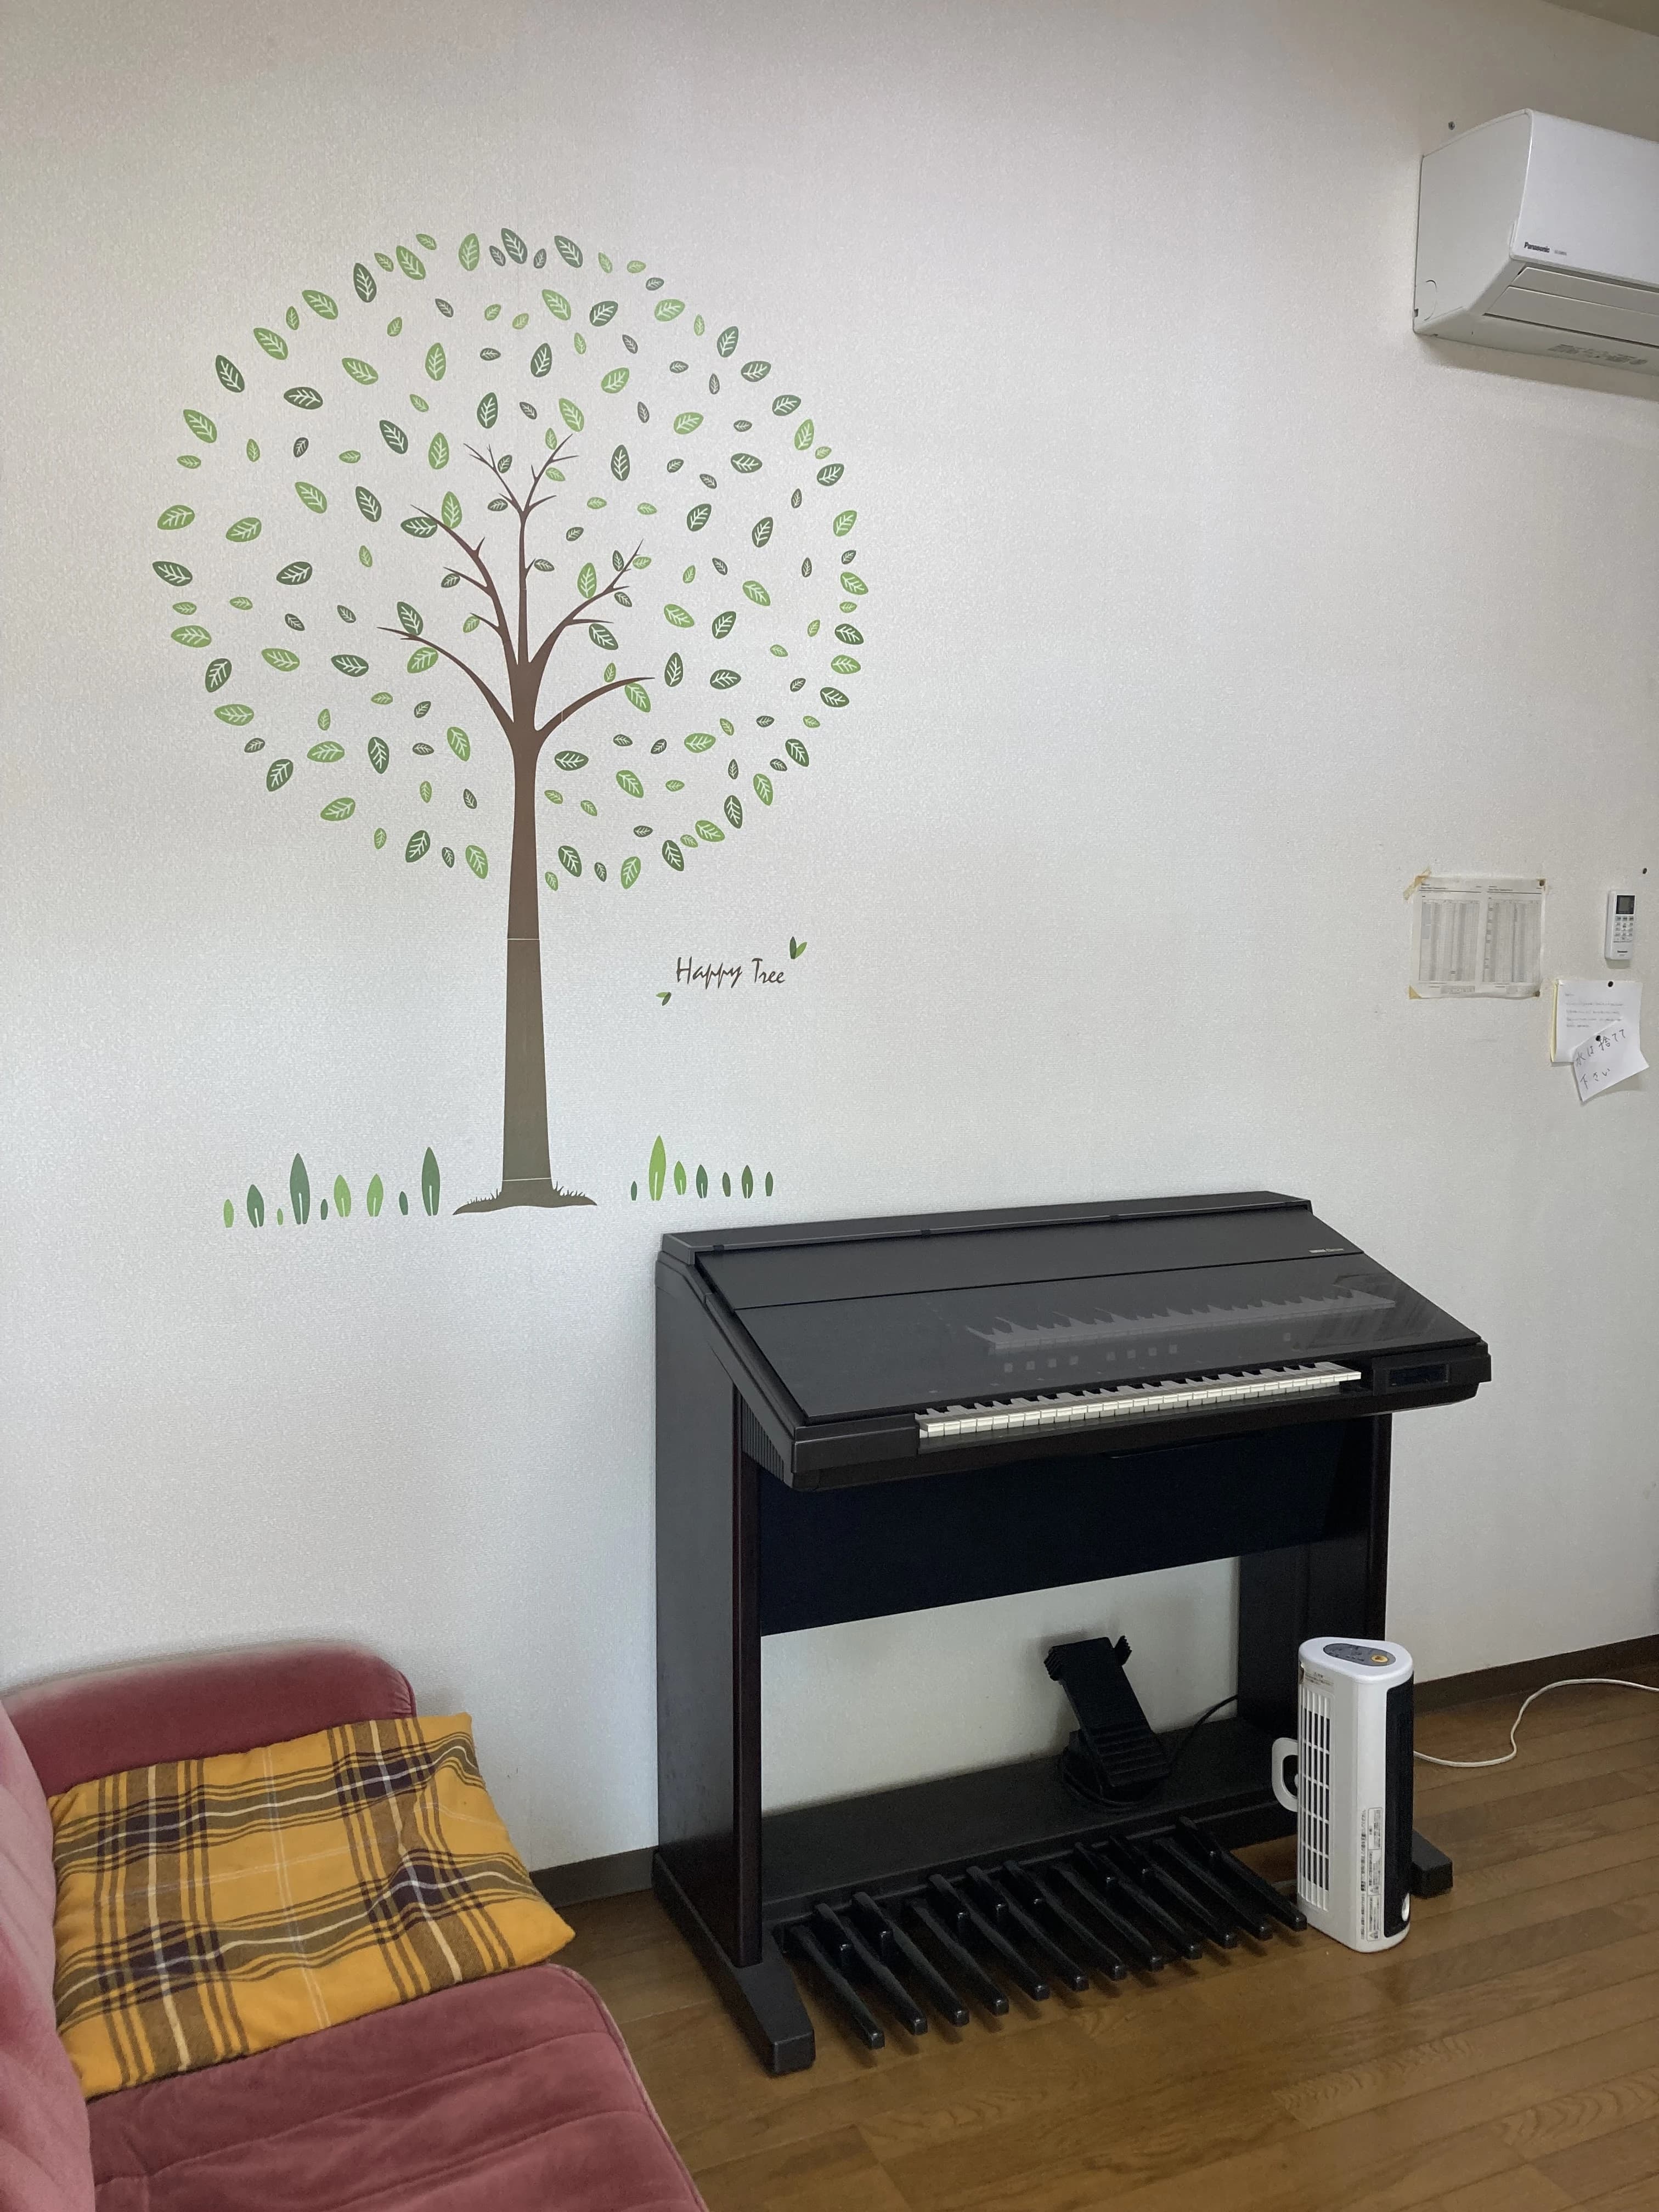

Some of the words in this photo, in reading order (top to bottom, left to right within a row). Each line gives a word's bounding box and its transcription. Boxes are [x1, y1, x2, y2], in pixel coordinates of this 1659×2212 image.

[1524, 242, 1550, 253] Panasonic
[676, 956, 742, 990] Happy
[752, 958, 785, 984] Tree
[1580, 1068, 1611, 1090] 下さい
